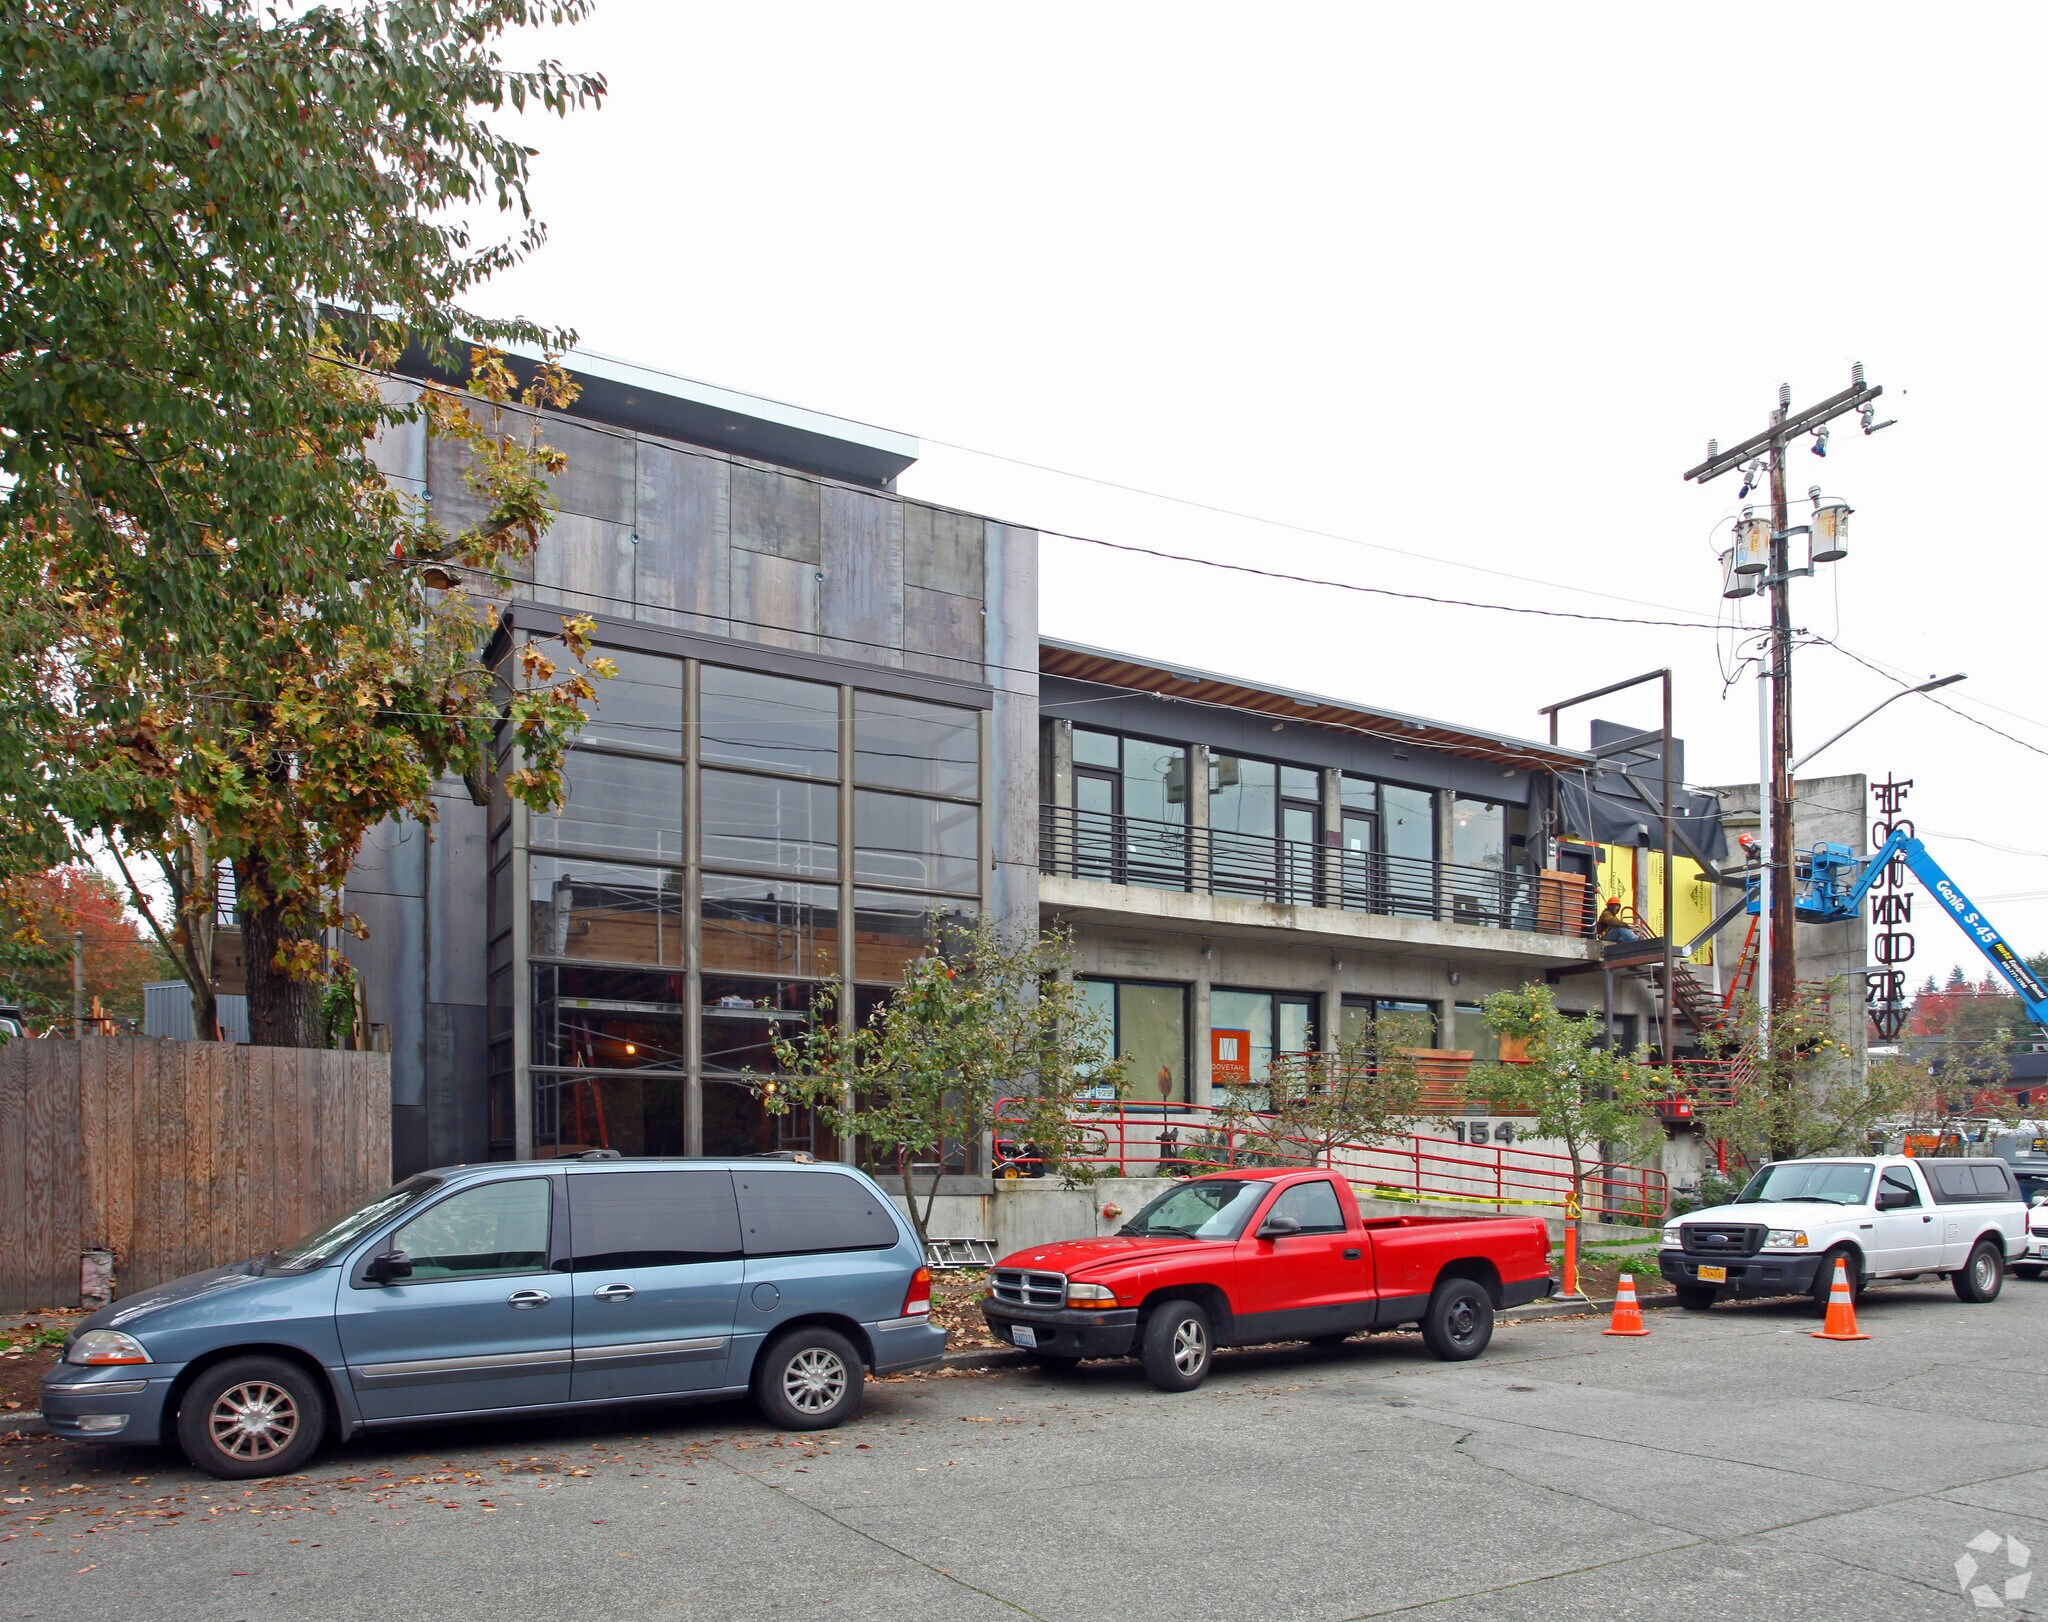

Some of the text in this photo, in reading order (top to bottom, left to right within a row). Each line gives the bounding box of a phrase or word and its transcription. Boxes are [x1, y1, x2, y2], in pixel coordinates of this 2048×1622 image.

[1936, 880, 1998, 943] Genie S-45
[1994, 943, 2013, 960] Hertz
[1211, 1063, 1245, 1071] DOVETAIL
[1456, 1121, 1515, 1144] 154
